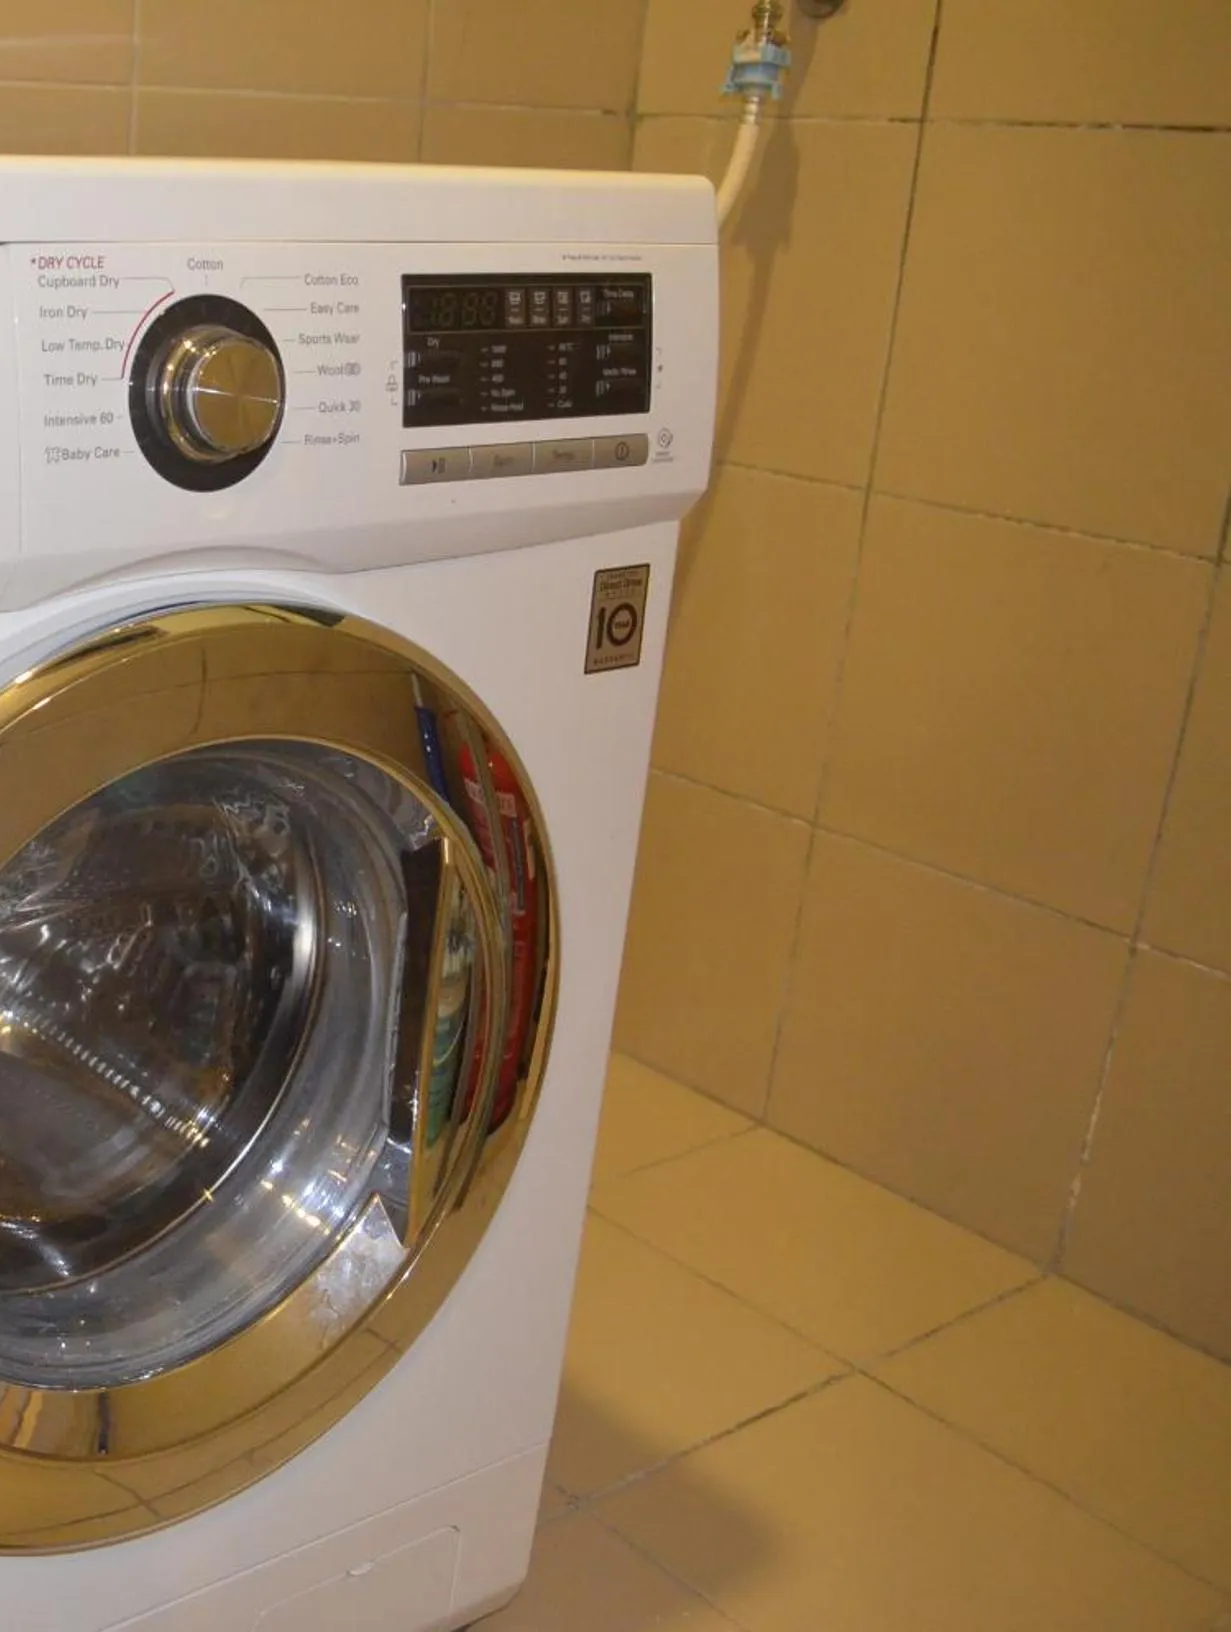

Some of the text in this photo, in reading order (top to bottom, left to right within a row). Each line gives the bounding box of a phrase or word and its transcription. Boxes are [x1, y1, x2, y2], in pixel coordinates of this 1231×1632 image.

[38, 256, 105, 270] DRY CYCLE
[186, 257, 223, 271] Cotton
[37, 275, 120, 289] Cupboard Dry
[304, 273, 359, 286] Cotton Eco
[39, 305, 88, 319] Iron Dry
[310, 302, 360, 315] Easy Care
[41, 339, 65, 352] Low
[105, 337, 125, 351] Dry
[298, 333, 361, 345] Sports Wear
[317, 365, 343, 377] Wool
[43, 373, 98, 386] Time Dry
[318, 401, 362, 414] Quick 30
[44, 411, 114, 427] Intensive 60
[62, 446, 120, 461] Baby Care
[595, 602, 638, 650] 10
